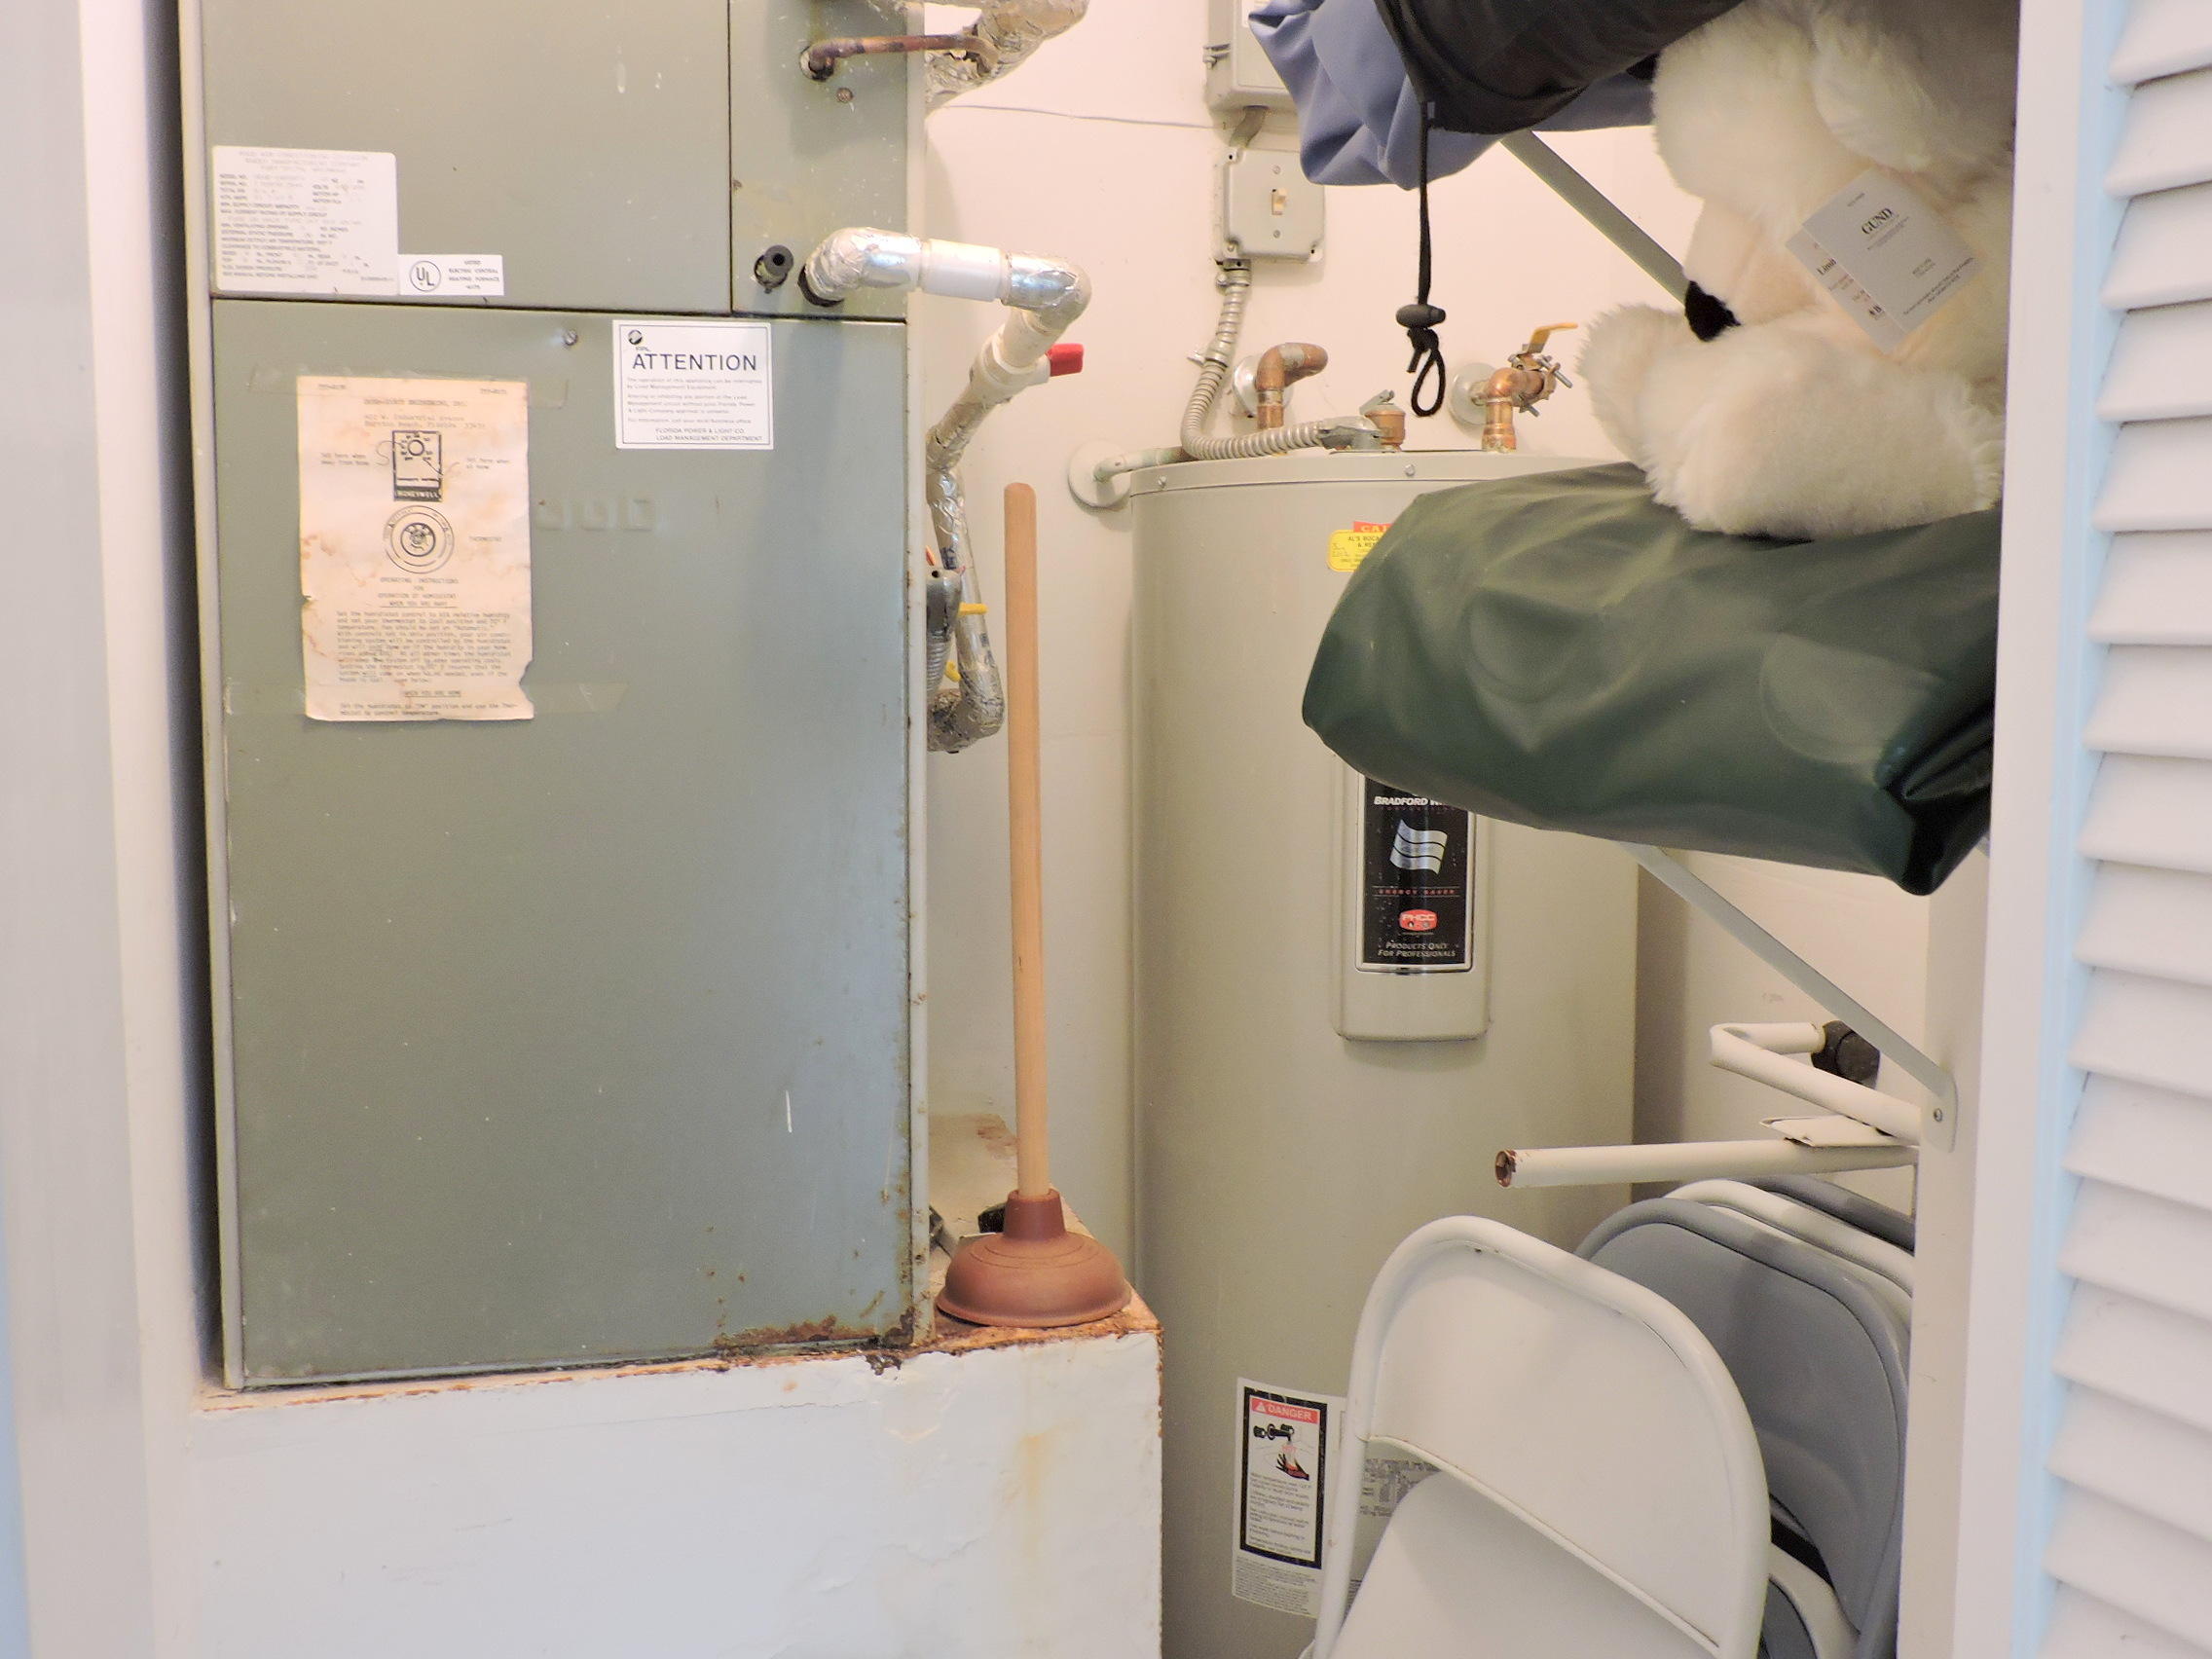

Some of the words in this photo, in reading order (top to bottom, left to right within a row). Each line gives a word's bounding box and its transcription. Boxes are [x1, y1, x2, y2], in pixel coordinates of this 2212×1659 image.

[1861, 207, 1894, 236] GUND
[632, 353, 756, 371] ATTENTION
[1374, 795, 1429, 806] BRADFORD
[1268, 1404, 1312, 1421] DANGER
